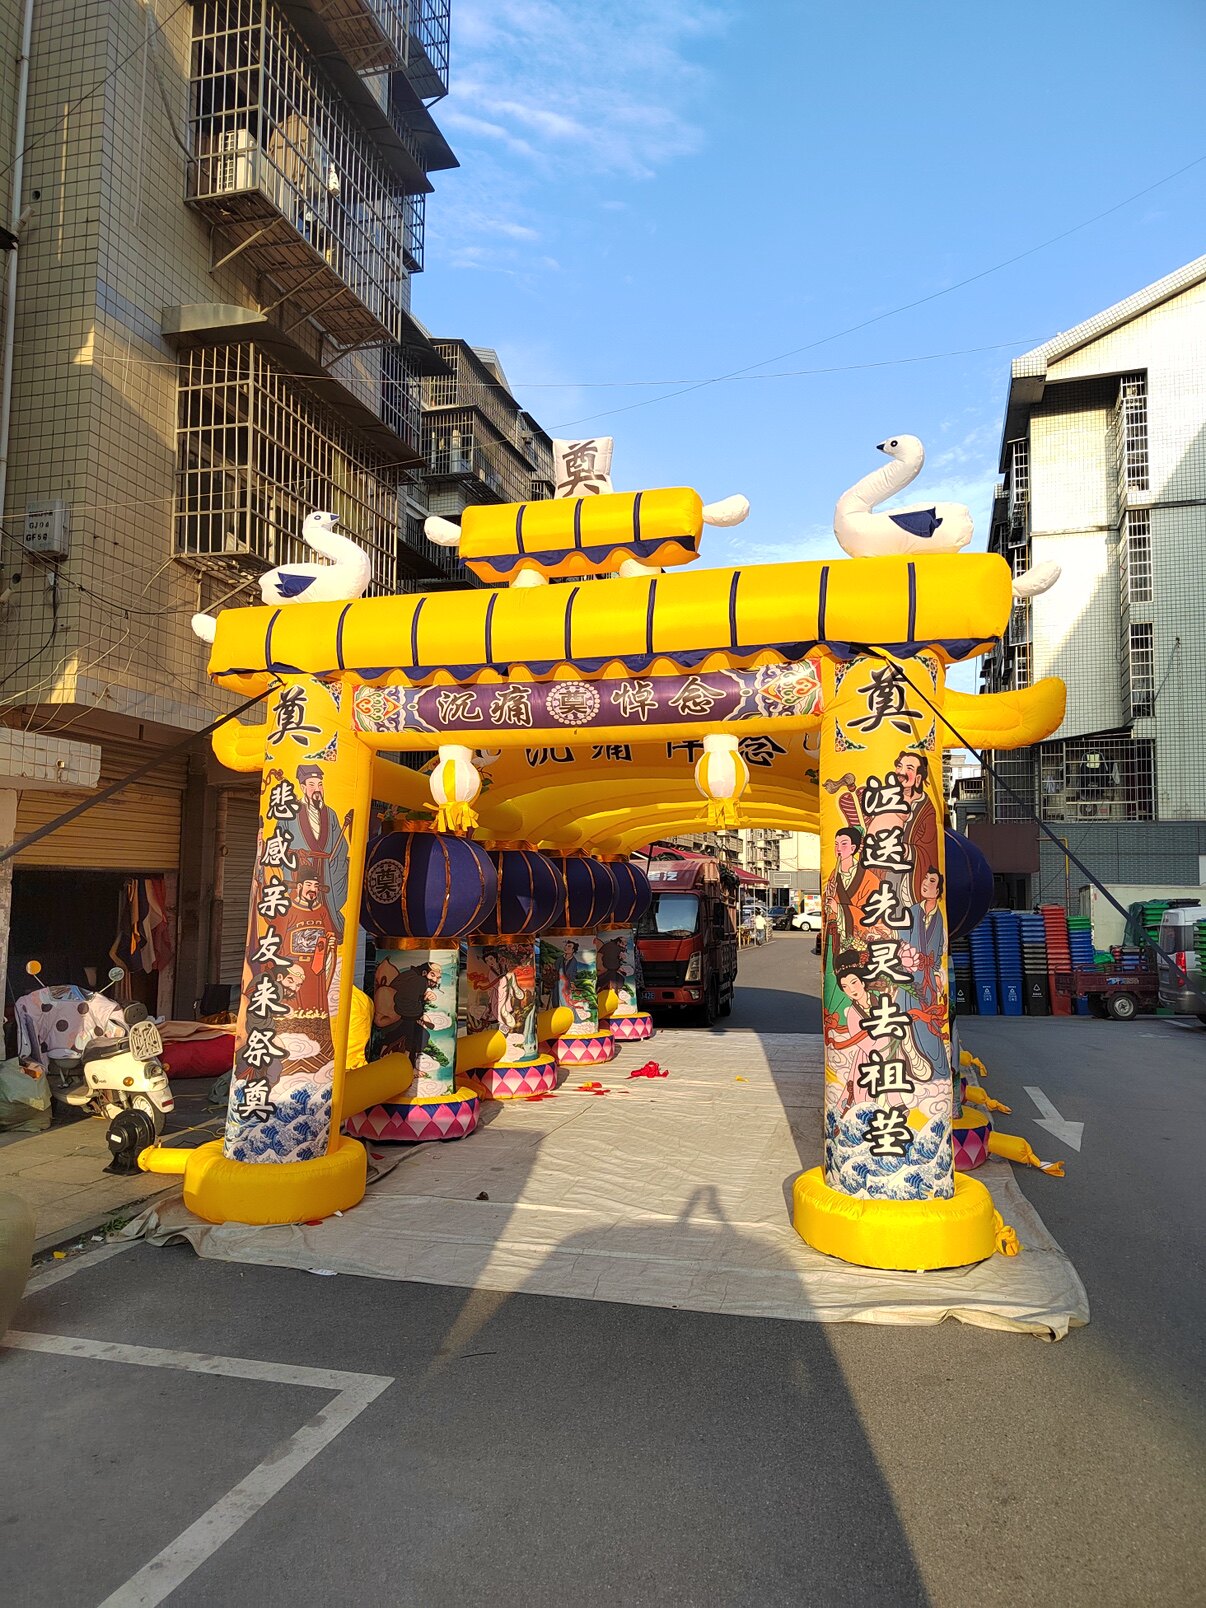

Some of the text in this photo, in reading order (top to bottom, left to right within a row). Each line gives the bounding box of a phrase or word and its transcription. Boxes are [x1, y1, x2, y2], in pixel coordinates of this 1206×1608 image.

[558, 440, 607, 498] 奠
[267, 684, 322, 747] 奠
[847, 666, 922, 735] 奠
[238, 782, 299, 1122] 悲感亲友来祭奠
[859, 773, 913, 1157] 泣送先灵去祖茔
